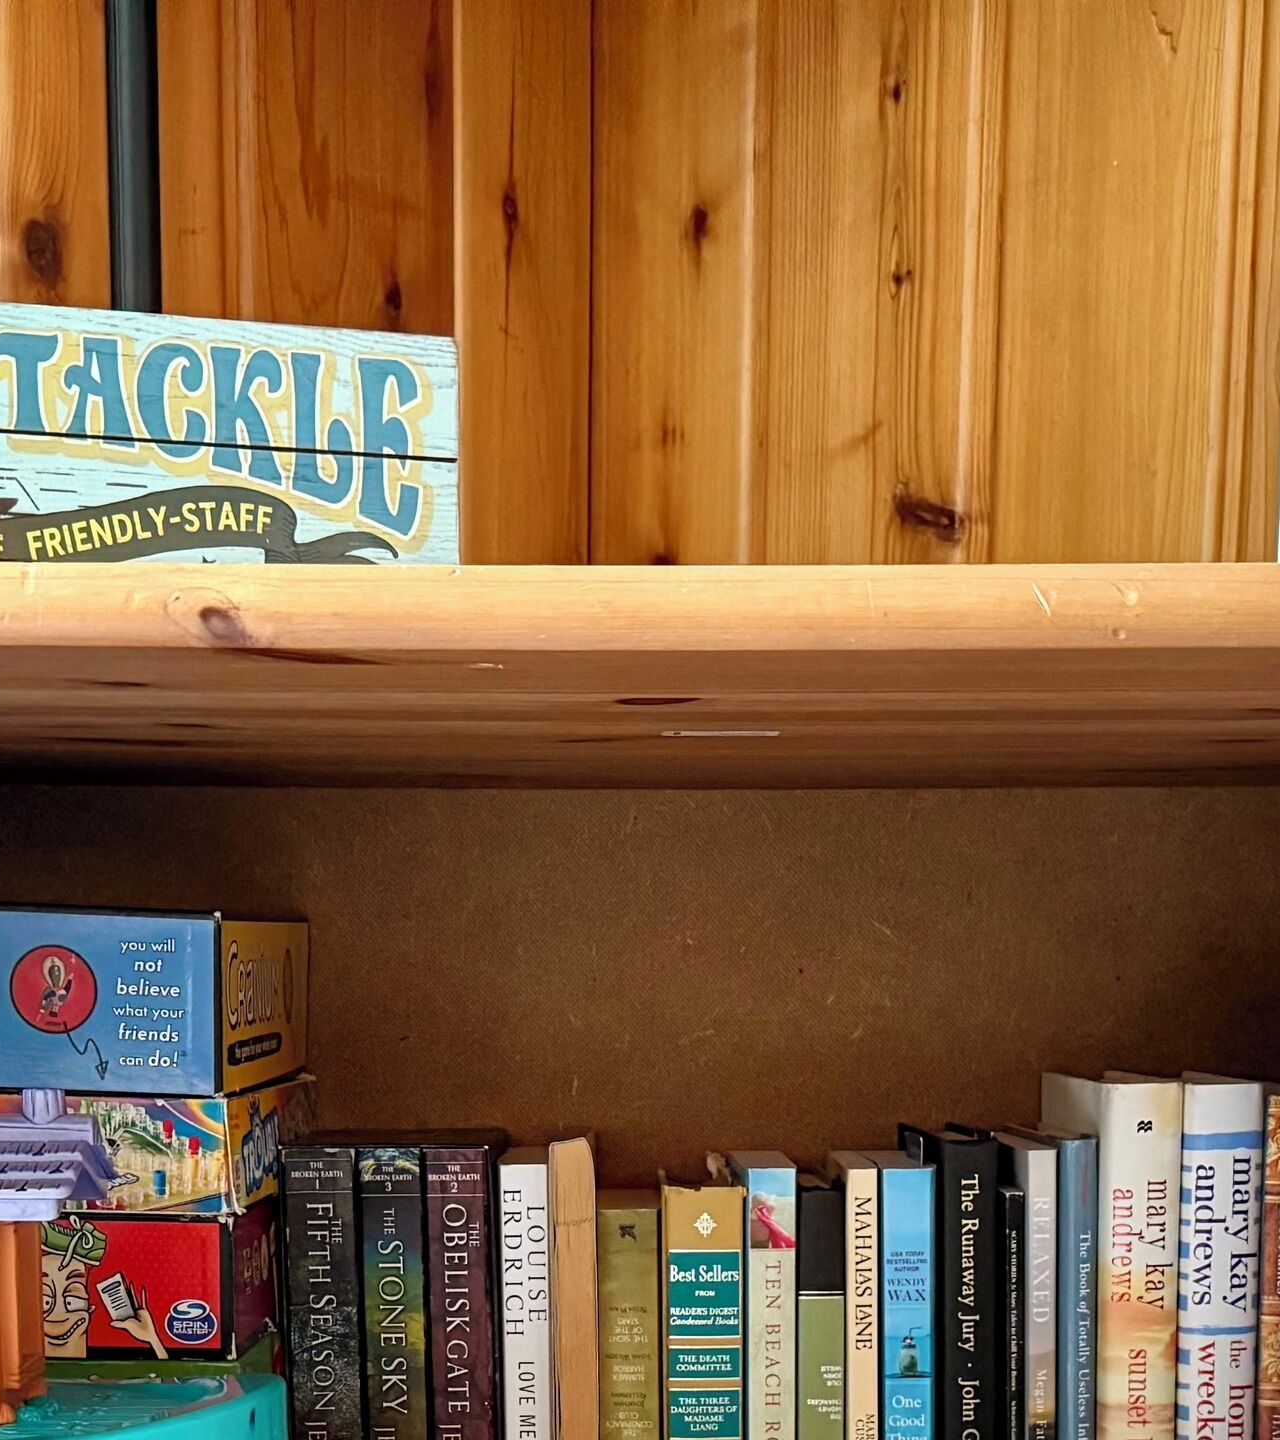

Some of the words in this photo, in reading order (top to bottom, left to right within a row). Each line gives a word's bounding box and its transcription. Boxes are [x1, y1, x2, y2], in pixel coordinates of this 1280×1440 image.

[26, 502, 275, 562] FRIENDLY-STAFF
[120, 942, 146, 955] you
[151, 938, 176, 952] will
[133, 959, 163, 972] not
[116, 977, 181, 997] believe
[113, 1003, 148, 1017] what
[152, 1008, 185, 1020] your
[118, 1023, 179, 1042] friends
[119, 1056, 144, 1067] can
[147, 1049, 180, 1068] do!
[960, 1173, 980, 1214] The
[1138, 1178, 1167, 1251] mary
[1224, 1155, 1252, 1246] mary
[306, 1203, 334, 1284] FIFTH
[331, 1218, 343, 1244] THE
[383, 1207, 396, 1235] THE
[468, 1220, 480, 1248] THE
[1191, 1164, 1227, 1306] andrews
[502, 1188, 525, 1337] ERDRICH
[526, 1205, 547, 1323] LOUISE
[854, 1196, 873, 1299] MAHALAS
[958, 1219, 980, 1307] Runaway
[1032, 1197, 1051, 1324] RELAXED
[1079, 1231, 1091, 1258] The
[1111, 1188, 1143, 1303] andrews
[442, 1203, 471, 1333] OBELISK
[669, 1264, 696, 1282] Best
[698, 1264, 740, 1282] Sellers
[764, 1261, 781, 1309] TEN
[887, 1277, 927, 1287] WENDY
[1079, 1263, 1091, 1297] Book
[1144, 1261, 1173, 1311] kay
[1223, 1250, 1258, 1313] kay
[377, 1240, 407, 1347] STONE
[709, 1307, 739, 1315] DIGEST
[887, 1289, 927, 1302] WAX
[173, 1320, 209, 1330] SPIN
[855, 1304, 873, 1350] LANE
[958, 1312, 980, 1353] Jury
[1078, 1317, 1090, 1363] Totally
[309, 1294, 337, 1411] SEASON
[699, 1355, 730, 1363] DEATH
[764, 1322, 781, 1409] BEACH
[1229, 1340, 1240, 1369] the
[381, 1357, 408, 1414] SKY
[446, 1340, 471, 1414] GATE
[518, 1360, 535, 1408] LOVE
[958, 1374, 980, 1425] John
[1035, 1369, 1047, 1421] Megan
[1078, 1369, 1090, 1418] Useless
[1126, 1348, 1152, 1429] sunset
[670, 1406, 724, 1414] DAUGHTERS
[678, 1397, 698, 1405] THE
[700, 1397, 730, 1405] THREE
[888, 1414, 925, 1428] Good
[891, 1394, 922, 1409] One
